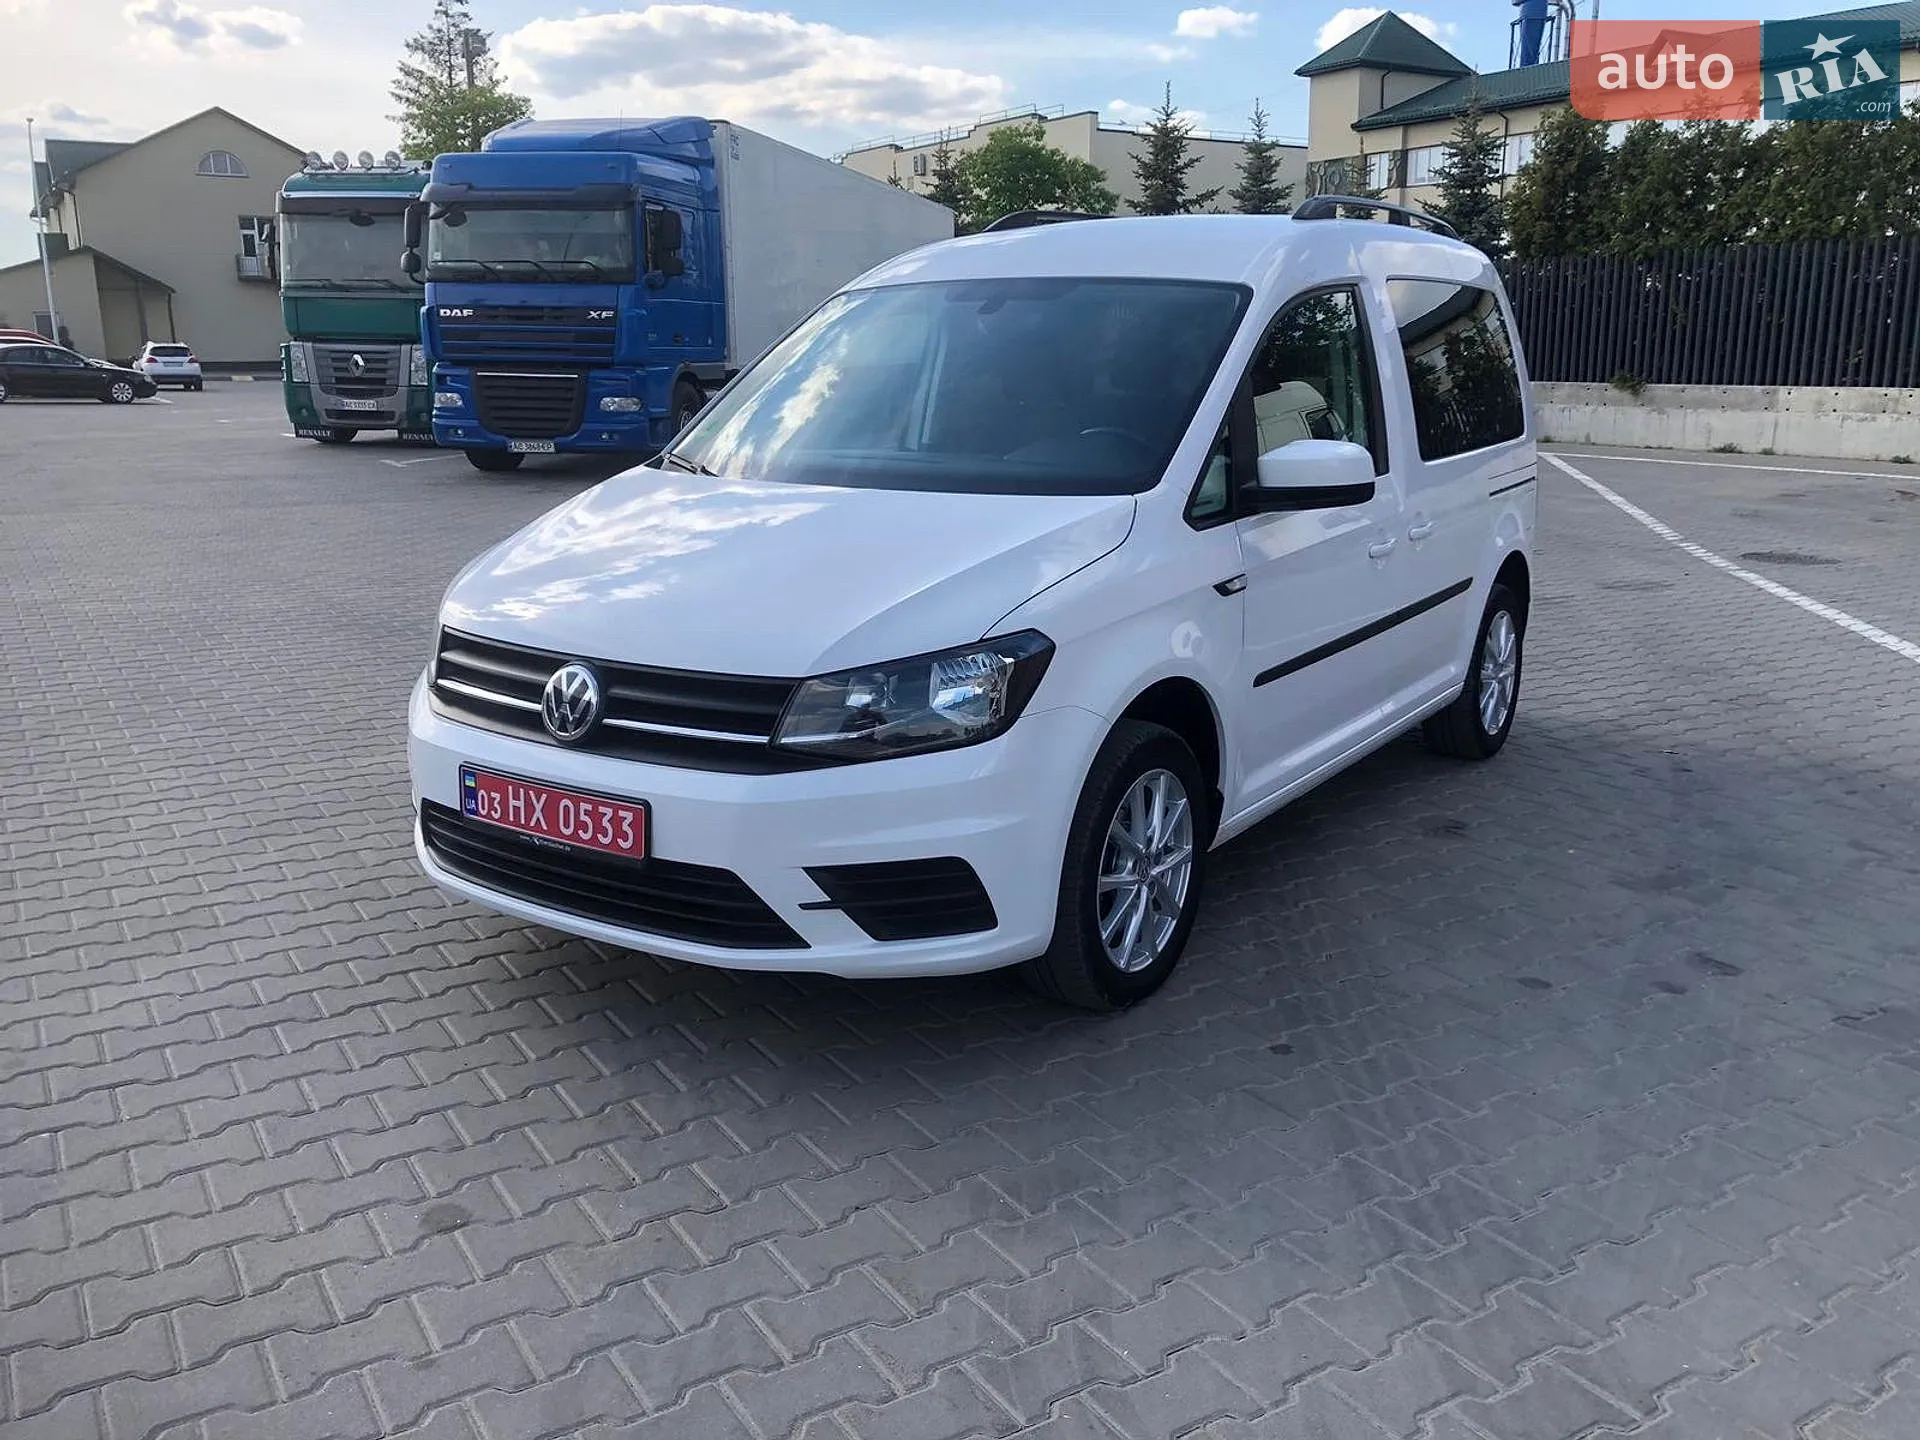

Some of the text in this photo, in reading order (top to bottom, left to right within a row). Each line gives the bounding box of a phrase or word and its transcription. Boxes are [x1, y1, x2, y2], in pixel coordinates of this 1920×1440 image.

[439, 308, 474, 317] DAF
[587, 310, 615, 319] XF
[299, 429, 331, 437] RENAULT
[465, 798, 477, 812] UA
[477, 785, 634, 850] 03 HX 0533
